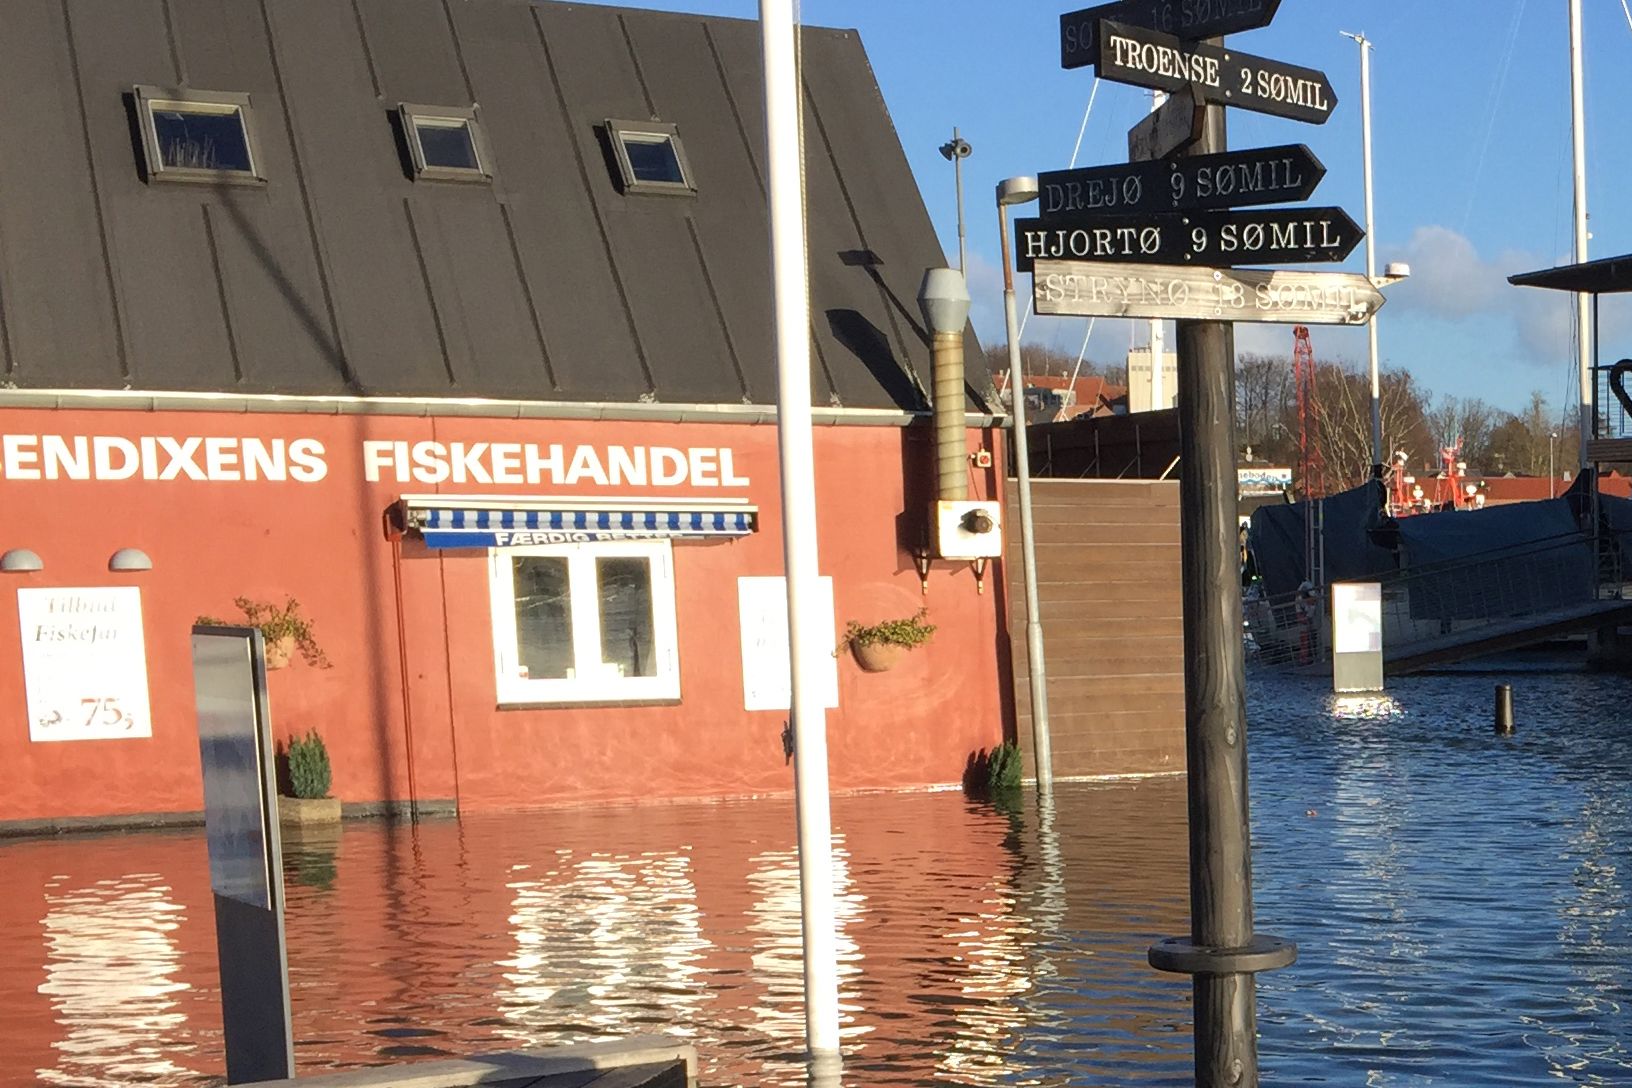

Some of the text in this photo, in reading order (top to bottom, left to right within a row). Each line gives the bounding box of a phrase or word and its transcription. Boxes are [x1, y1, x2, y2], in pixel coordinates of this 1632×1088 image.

[1110, 35, 1328, 111] TROENSE 2 SØMIL
[1045, 158, 1302, 213] DREJØ 9 SØMIL
[1024, 221, 1341, 258] HJORTØ 9 SØMIL
[1045, 272, 1367, 312] STRYNØ 18 SØMIL
[0, 434, 749, 487] ENDIXENS FISKEHANDEL
